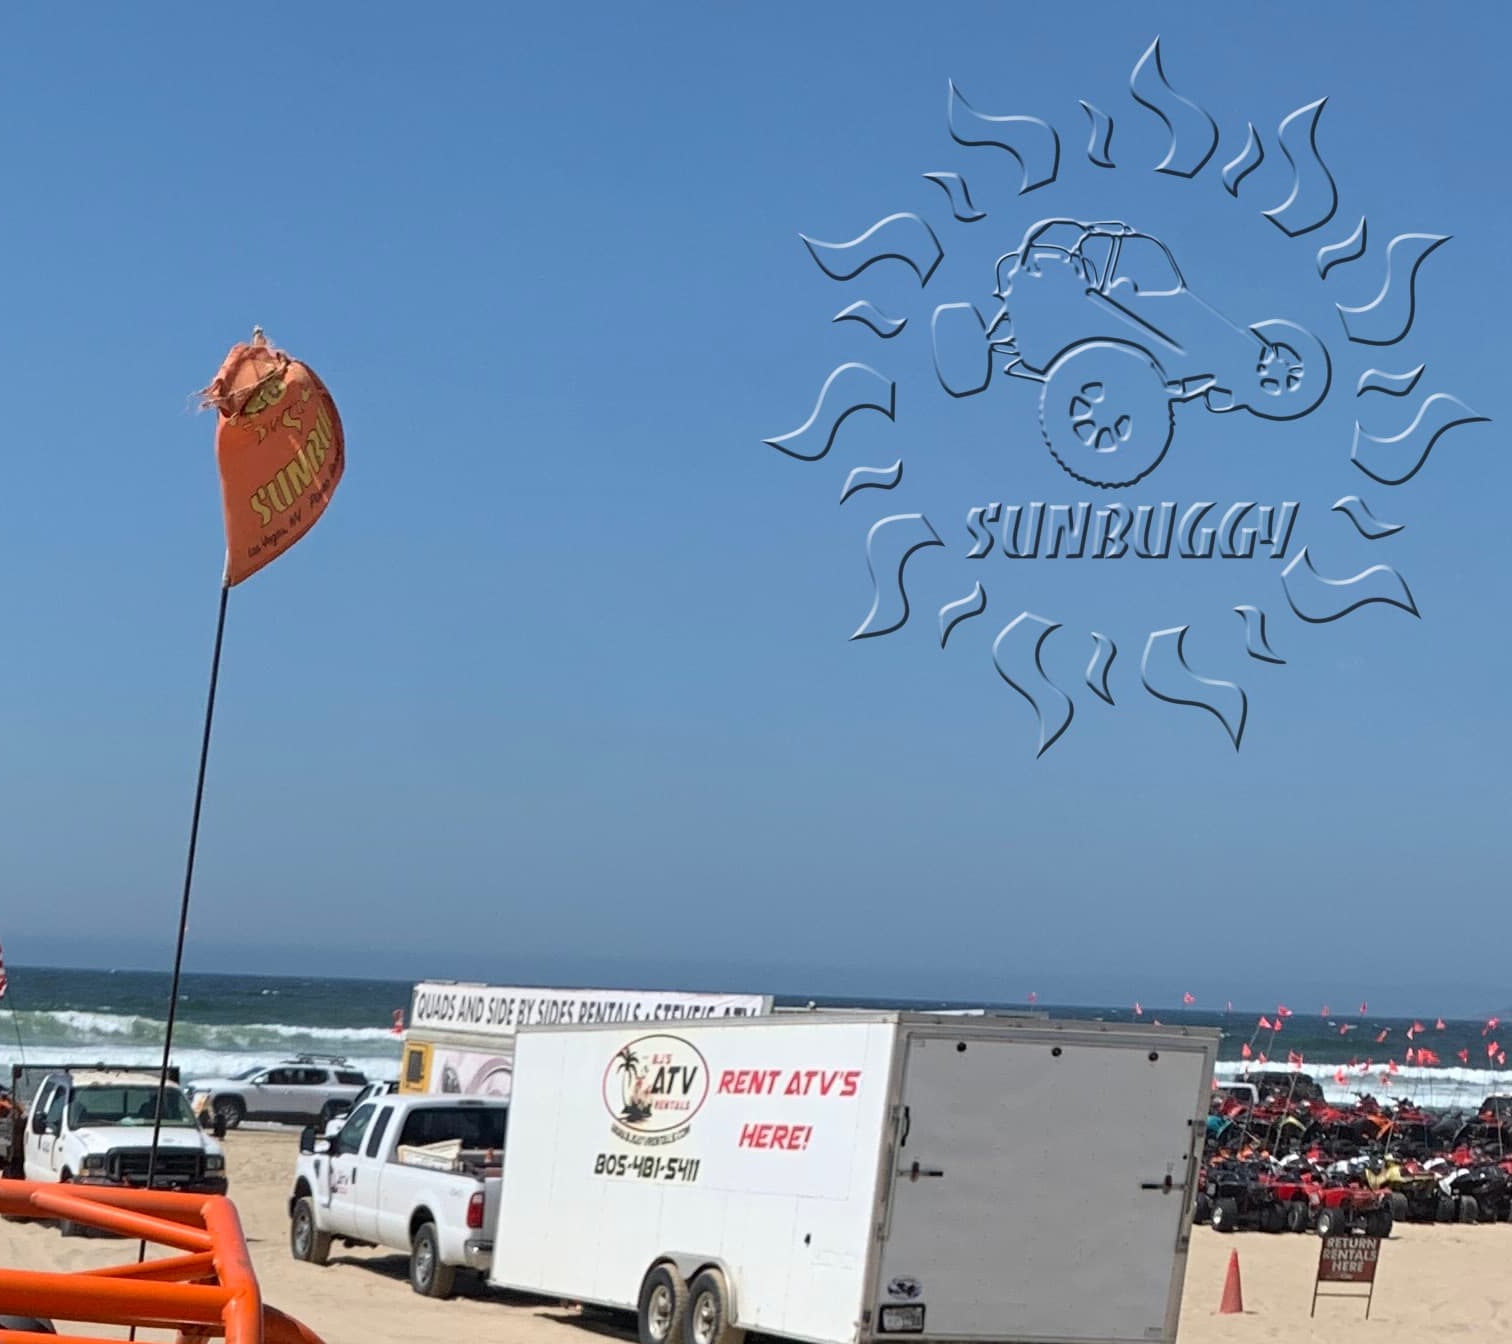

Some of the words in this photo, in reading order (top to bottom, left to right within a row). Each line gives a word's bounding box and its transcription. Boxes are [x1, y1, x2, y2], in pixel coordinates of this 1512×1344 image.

[251, 402, 332, 528] SUNBU
[418, 993, 457, 1020] QUADS
[457, 996, 485, 1023] AND
[487, 998, 515, 1025] SIDE
[517, 999, 536, 1025] BY
[538, 999, 574, 1025] SIDES
[579, 1001, 641, 1024] RENTALS
[651, 1066, 698, 1095] ATV
[717, 1070, 782, 1095] RENT
[784, 1070, 862, 1096] ATV'S
[738, 1123, 813, 1151] HERE!
[594, 1153, 701, 1182] 805-481-5411
[1323, 1249, 1377, 1261] RENTALS
[1327, 1237, 1377, 1249] RETURN
[1331, 1261, 1364, 1273] HERE
